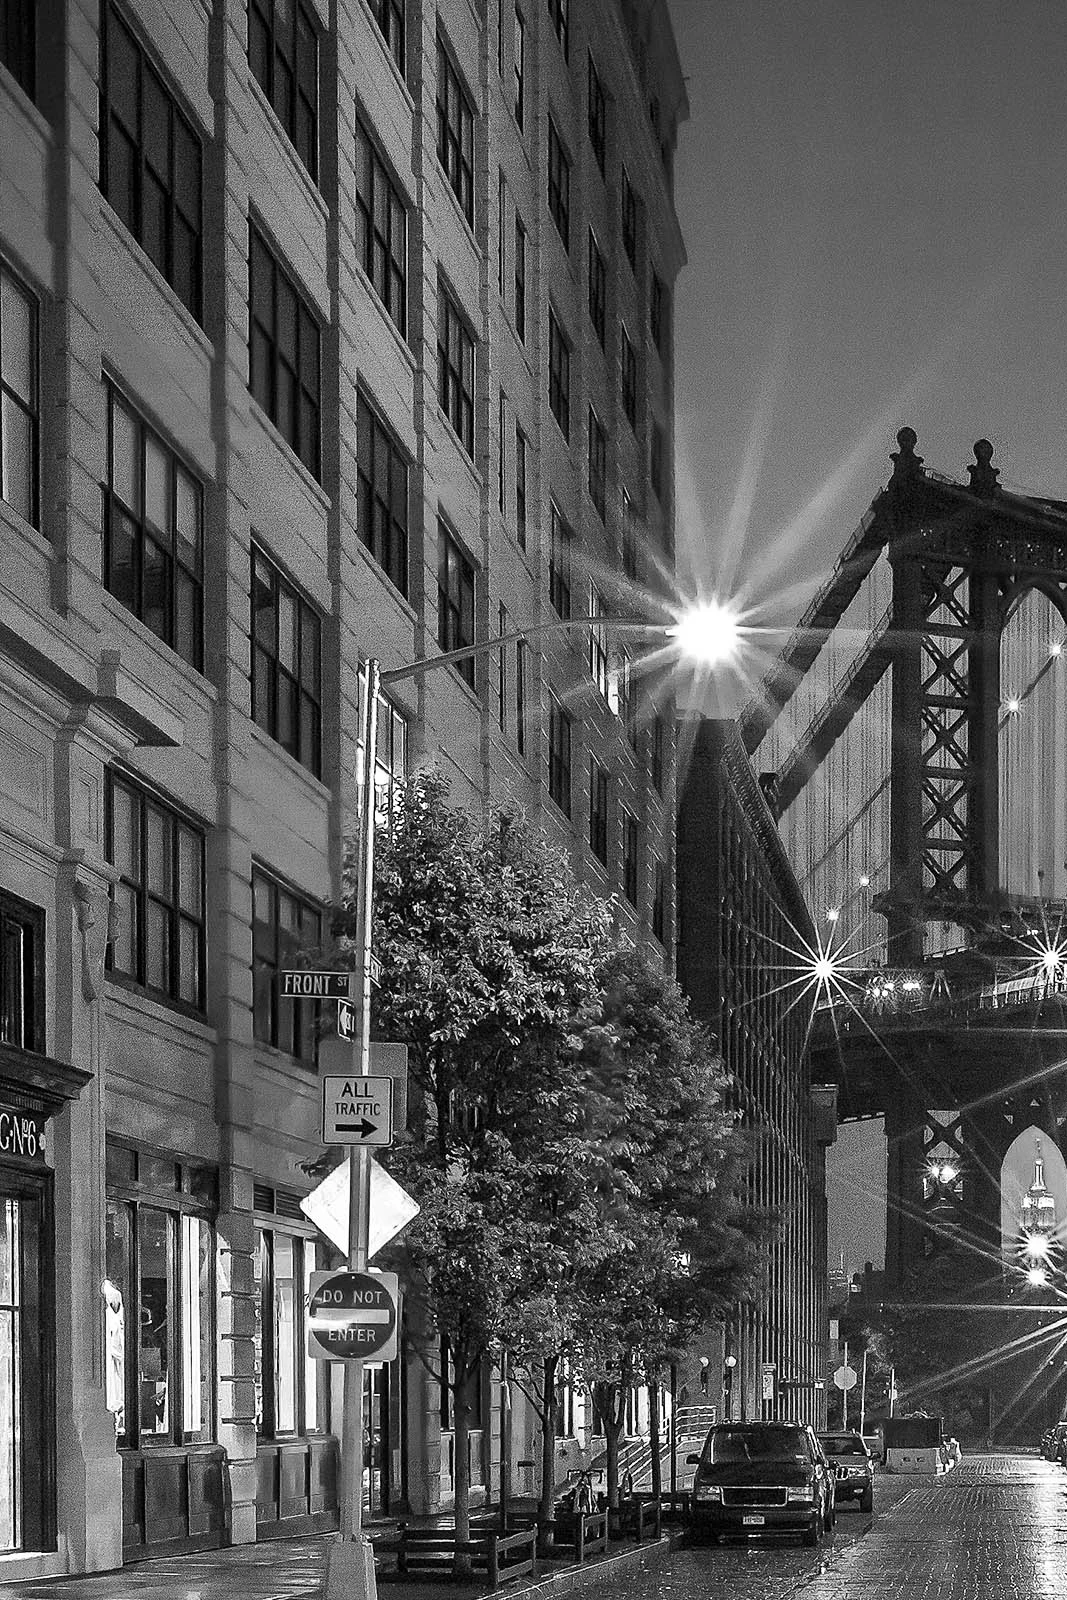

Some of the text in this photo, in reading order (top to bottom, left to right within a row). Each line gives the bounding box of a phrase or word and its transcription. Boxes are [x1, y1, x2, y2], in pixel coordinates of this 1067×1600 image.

[284, 974, 348, 995] FRONT ST
[341, 1081, 374, 1098] ALL
[335, 1102, 381, 1116] TRAFFIC
[323, 1289, 383, 1304] DO NOT
[328, 1328, 376, 1342] ENTER
